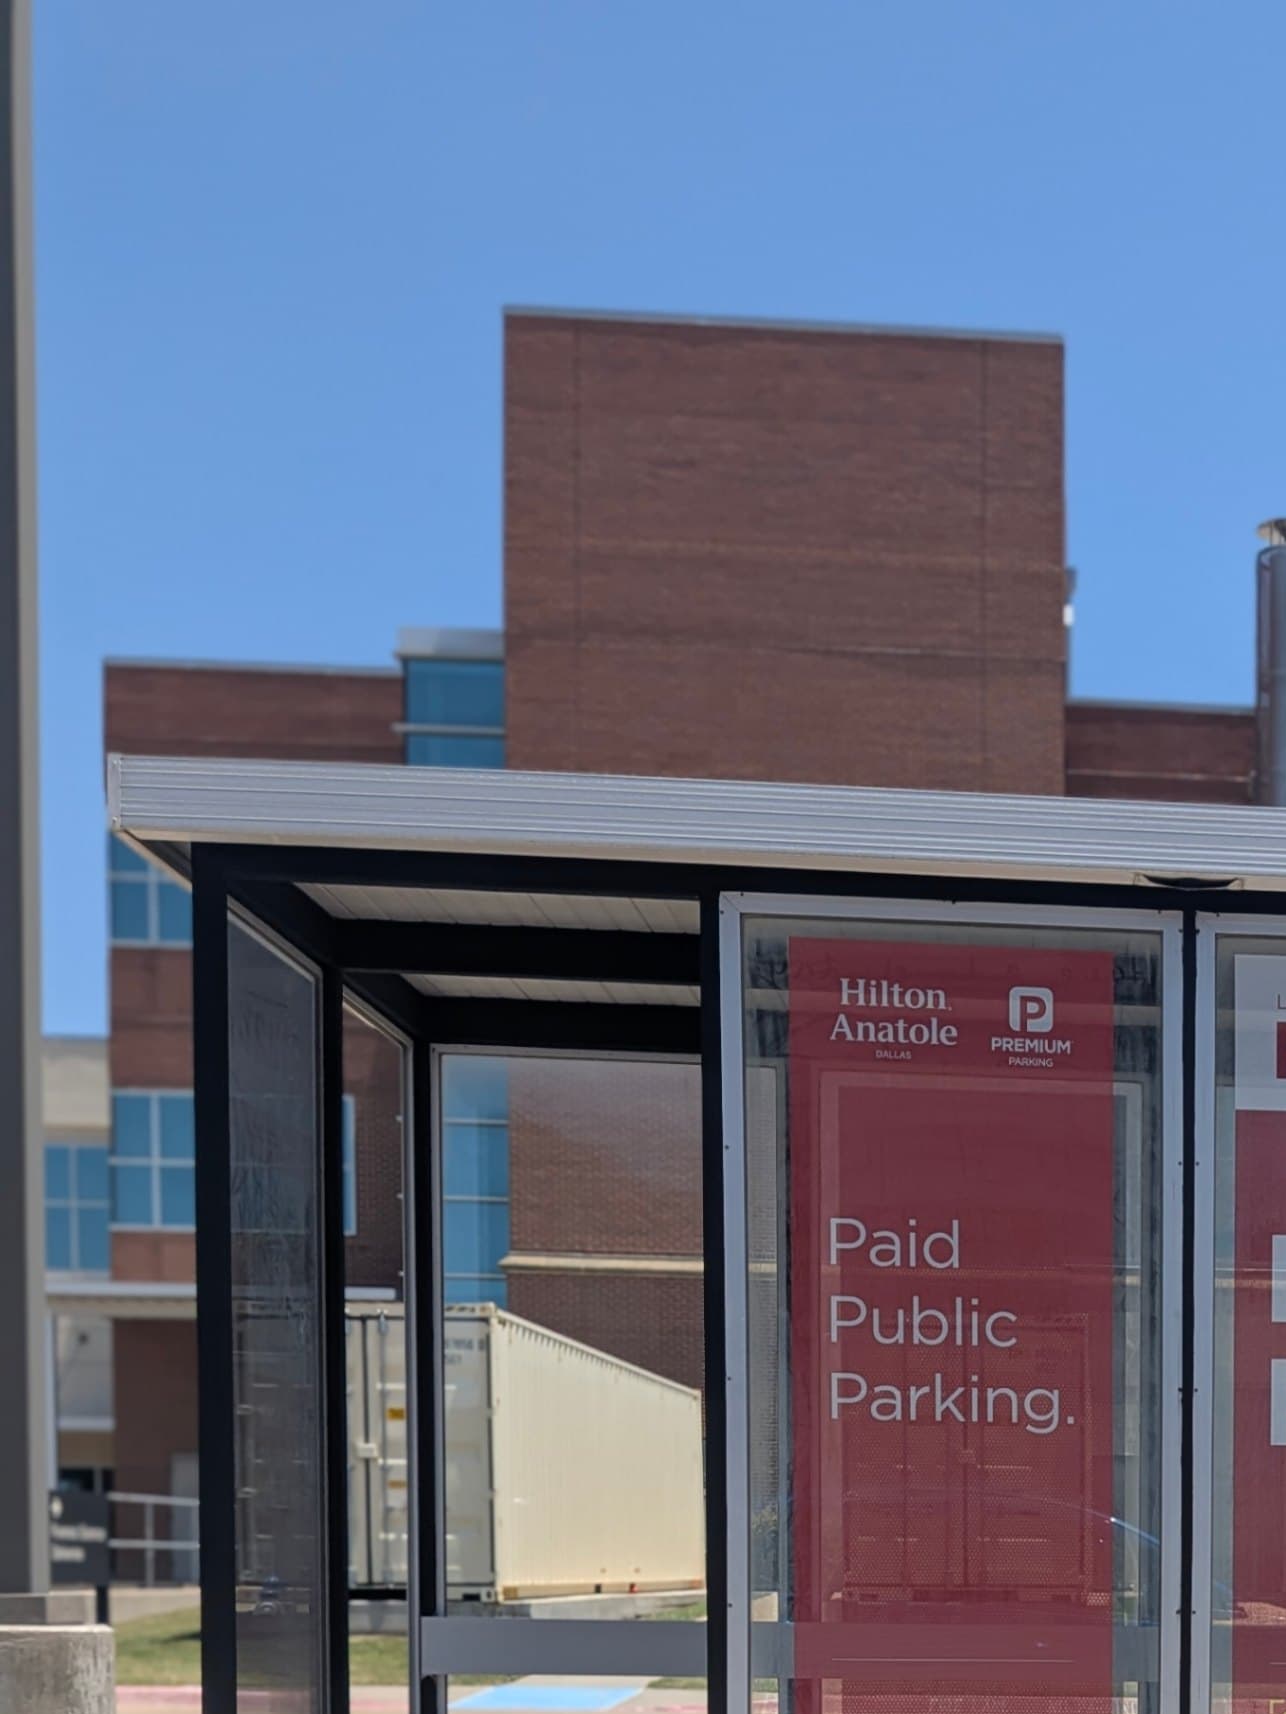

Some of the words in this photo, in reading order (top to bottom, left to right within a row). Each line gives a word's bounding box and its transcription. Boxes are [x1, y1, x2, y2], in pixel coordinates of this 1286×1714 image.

[830, 1013, 958, 1046] Anatole
[991, 1036, 1072, 1055] PREMIUM
[875, 1050, 912, 1060] DALLAS
[1008, 1056, 1054, 1067] PARKING
[829, 1217, 960, 1269] Paid
[829, 1295, 1018, 1348] Public
[829, 1372, 1075, 1434] Parking.
